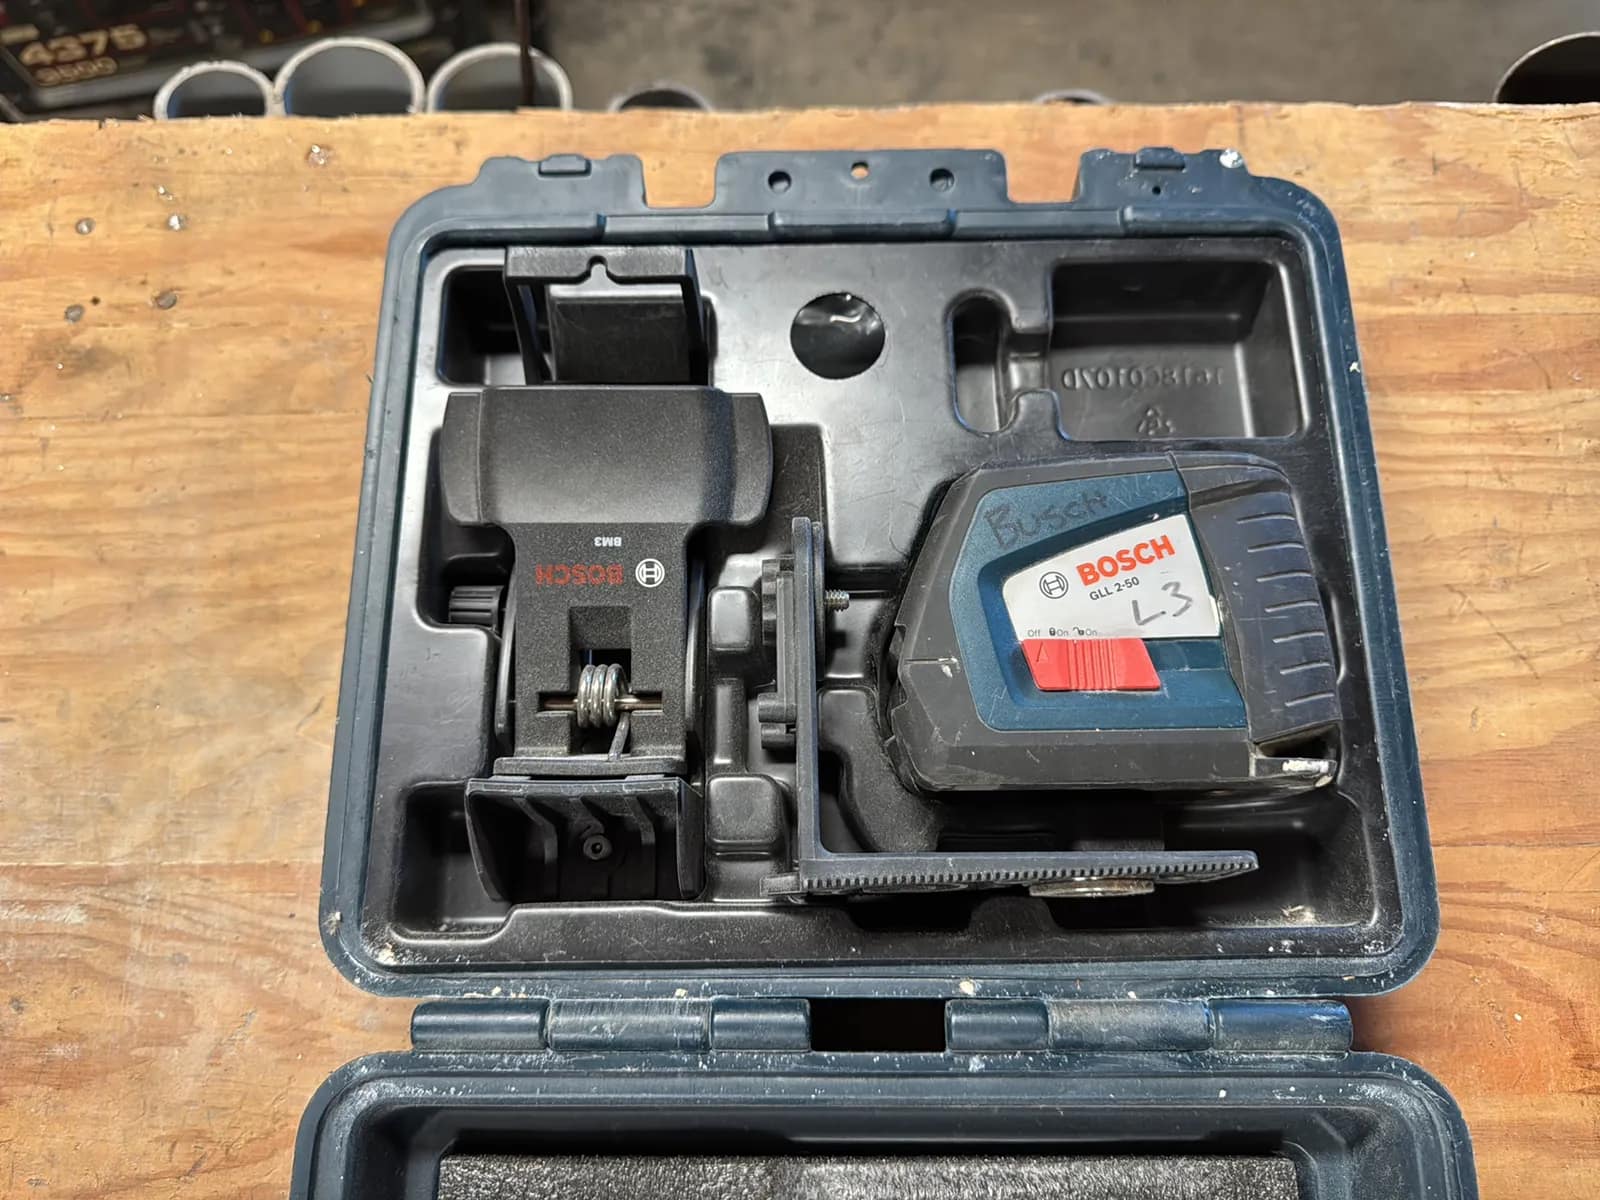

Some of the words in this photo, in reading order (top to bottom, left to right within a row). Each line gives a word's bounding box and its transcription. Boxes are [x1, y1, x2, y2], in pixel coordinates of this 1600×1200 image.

[594, 536, 622, 547] BM3
[1076, 534, 1176, 587] BOSCH
[535, 563, 624, 586] BOSCH
[1089, 582, 1114, 602] GLL
[1115, 575, 1140, 593] 2-50
[1027, 628, 1041, 637] Off
